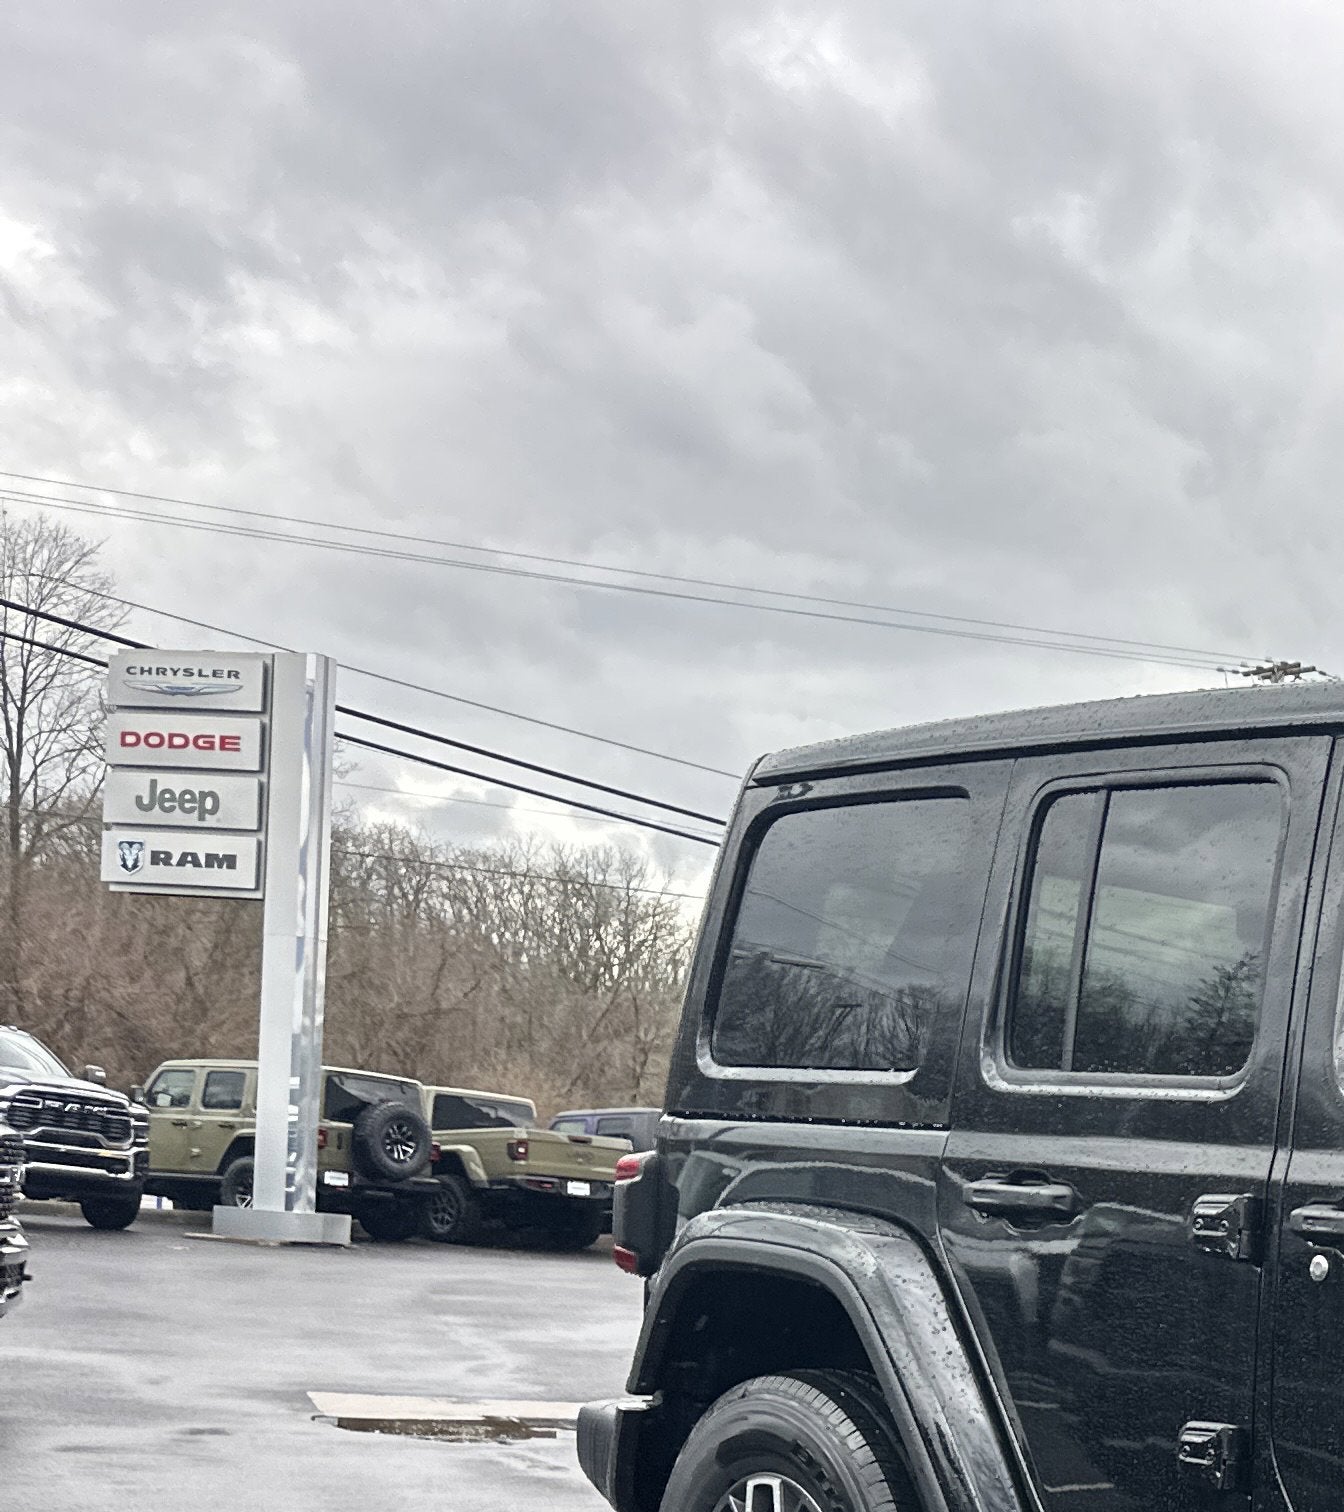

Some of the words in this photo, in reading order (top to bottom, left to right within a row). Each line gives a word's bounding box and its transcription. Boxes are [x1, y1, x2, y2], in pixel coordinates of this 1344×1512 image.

[125, 665, 241, 680] CHRYSLER
[119, 731, 242, 752] DODGE
[135, 778, 220, 822] Jeep
[150, 850, 237, 870] RAM
